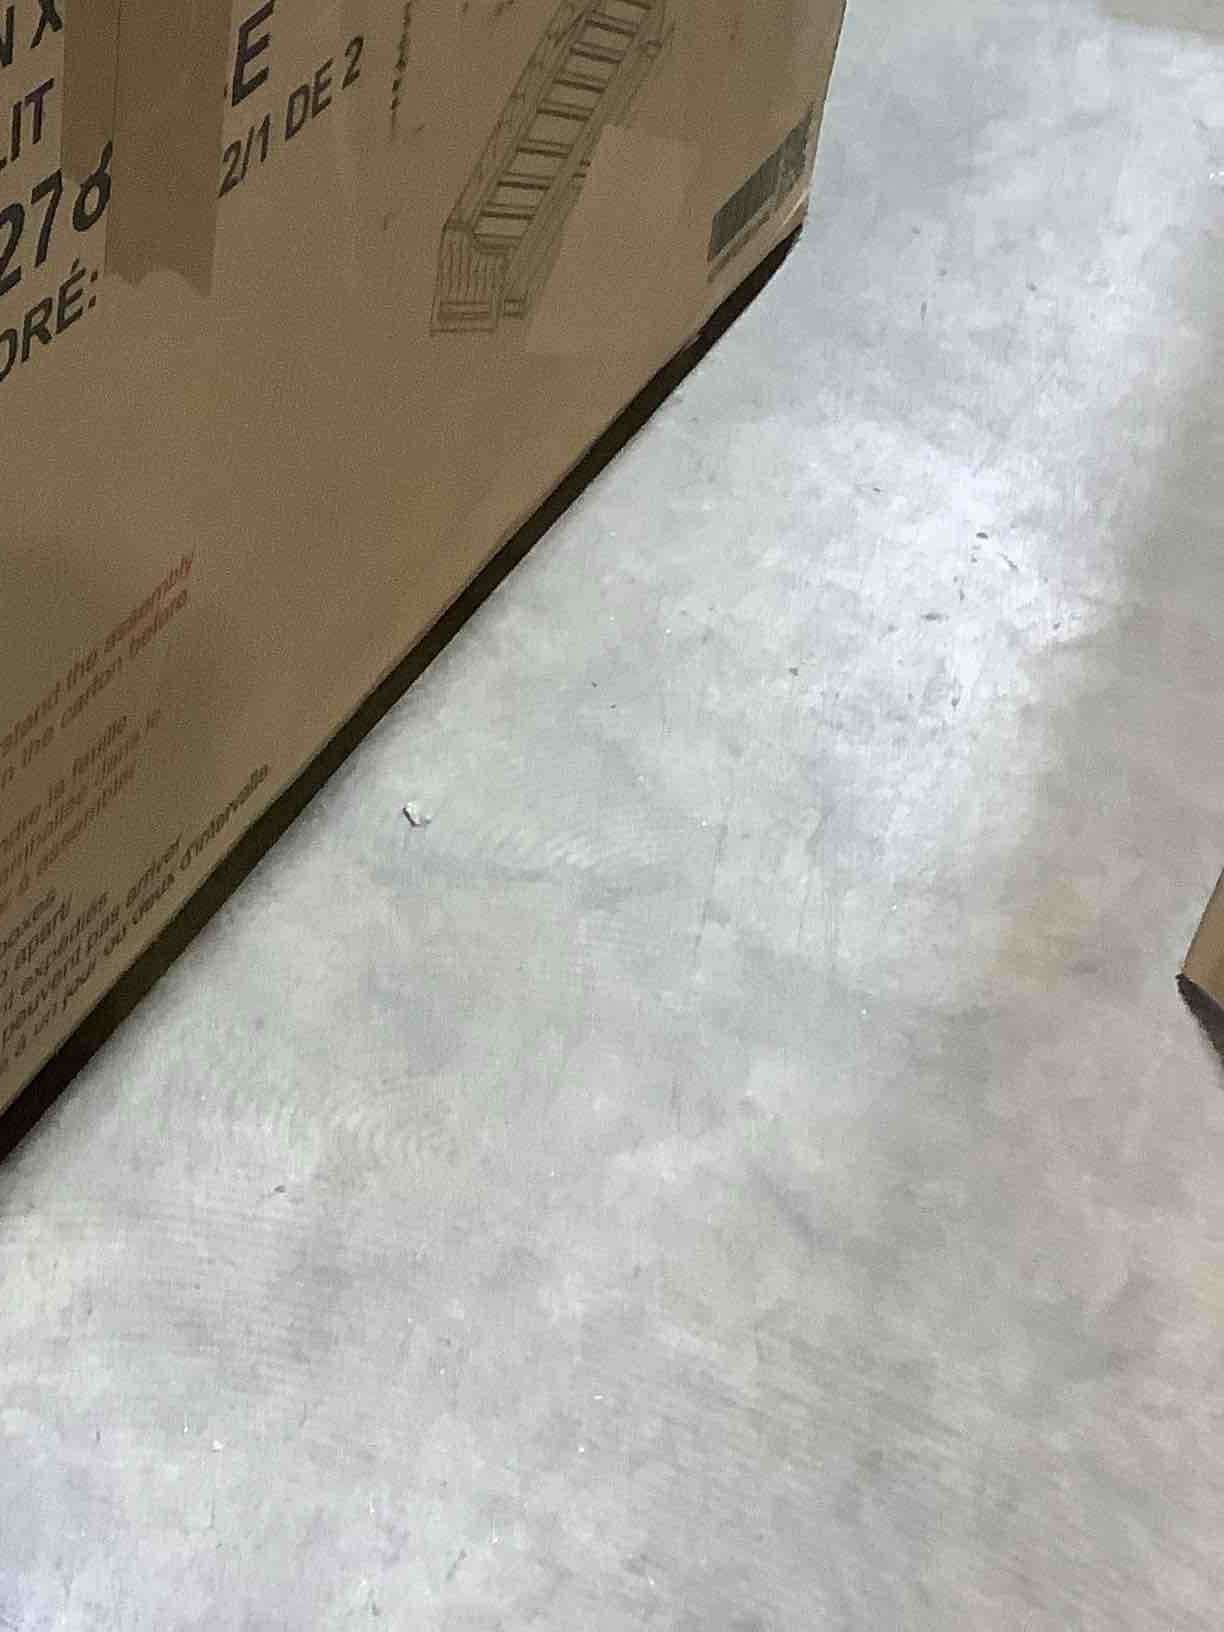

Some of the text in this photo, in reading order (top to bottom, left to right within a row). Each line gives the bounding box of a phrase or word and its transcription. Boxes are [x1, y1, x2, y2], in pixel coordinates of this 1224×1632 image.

[284, 58, 333, 141] DE
[341, 35, 365, 90] 2
[60, 655, 123, 729] carton
[66, 649, 99, 692] the
[1, 944, 82, 1051] peuvent
[85, 904, 121, 957] pas
[125, 833, 183, 909] arriver
[102, 923, 128, 957] ou
